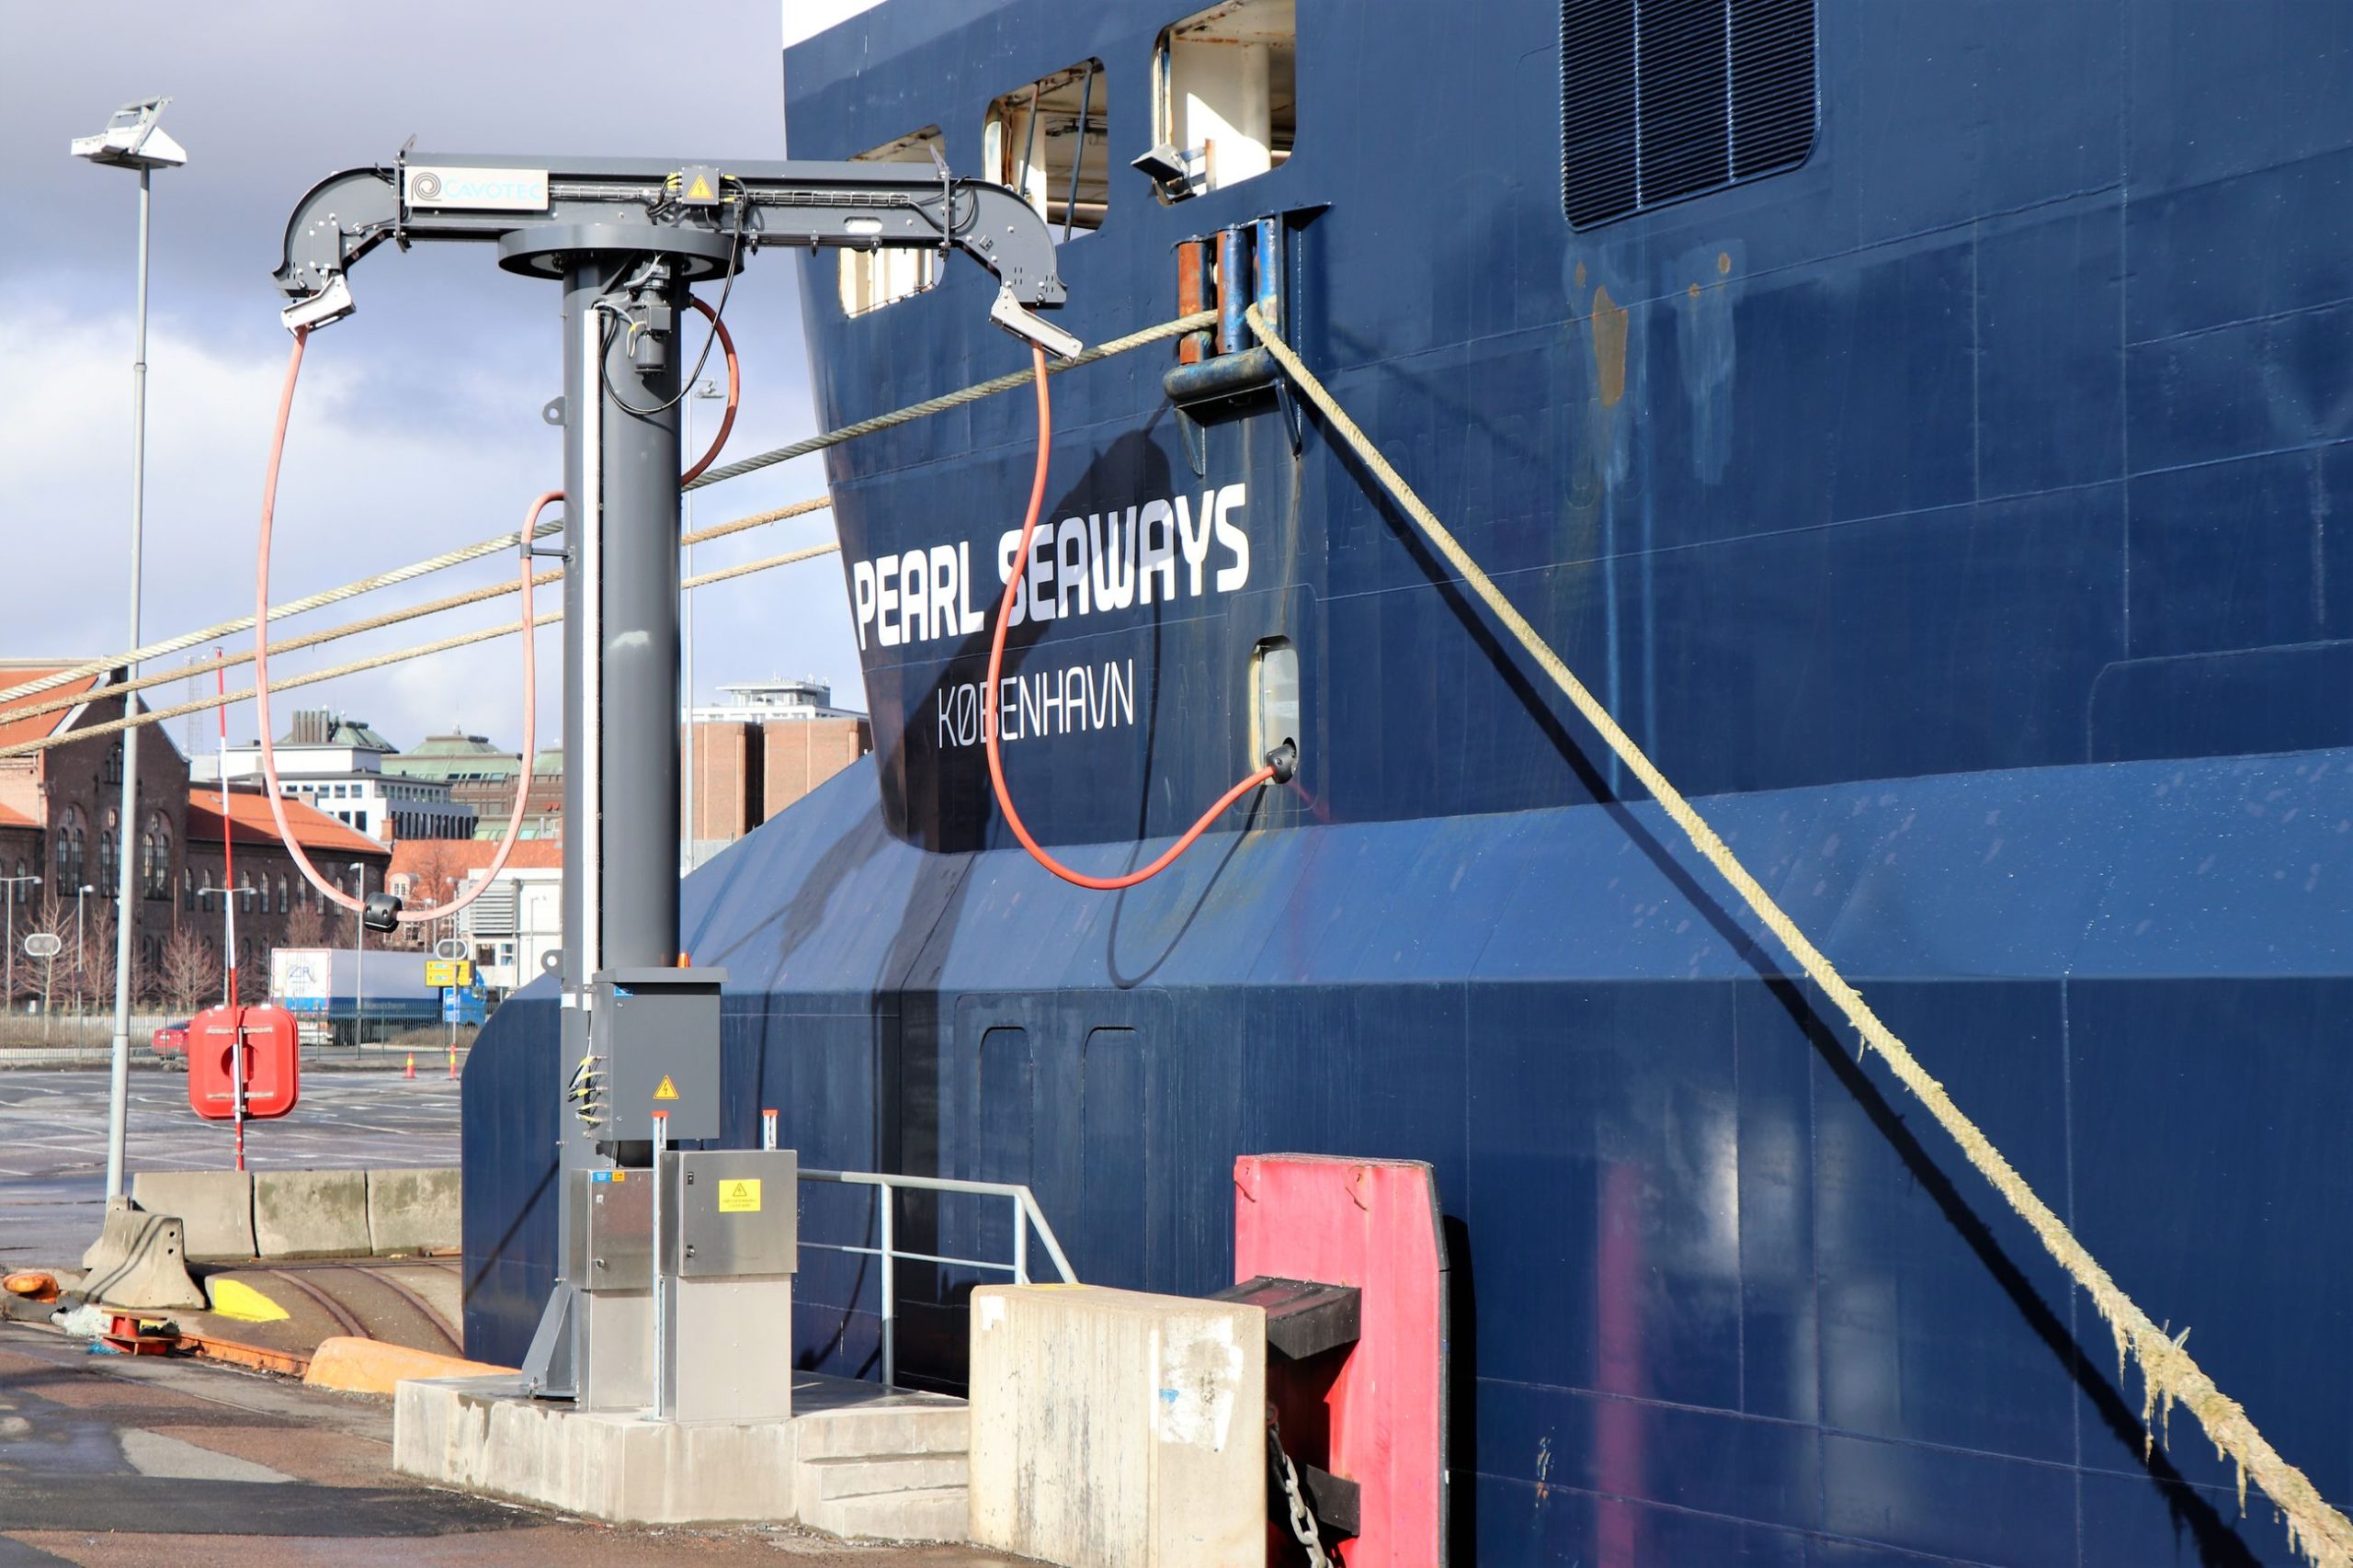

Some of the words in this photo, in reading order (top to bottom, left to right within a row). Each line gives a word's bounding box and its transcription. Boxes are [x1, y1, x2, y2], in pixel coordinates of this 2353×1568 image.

[443, 177, 543, 200] CAVOTEC
[853, 540, 985, 651] PEARL
[998, 483, 1250, 628] SEAWAYS
